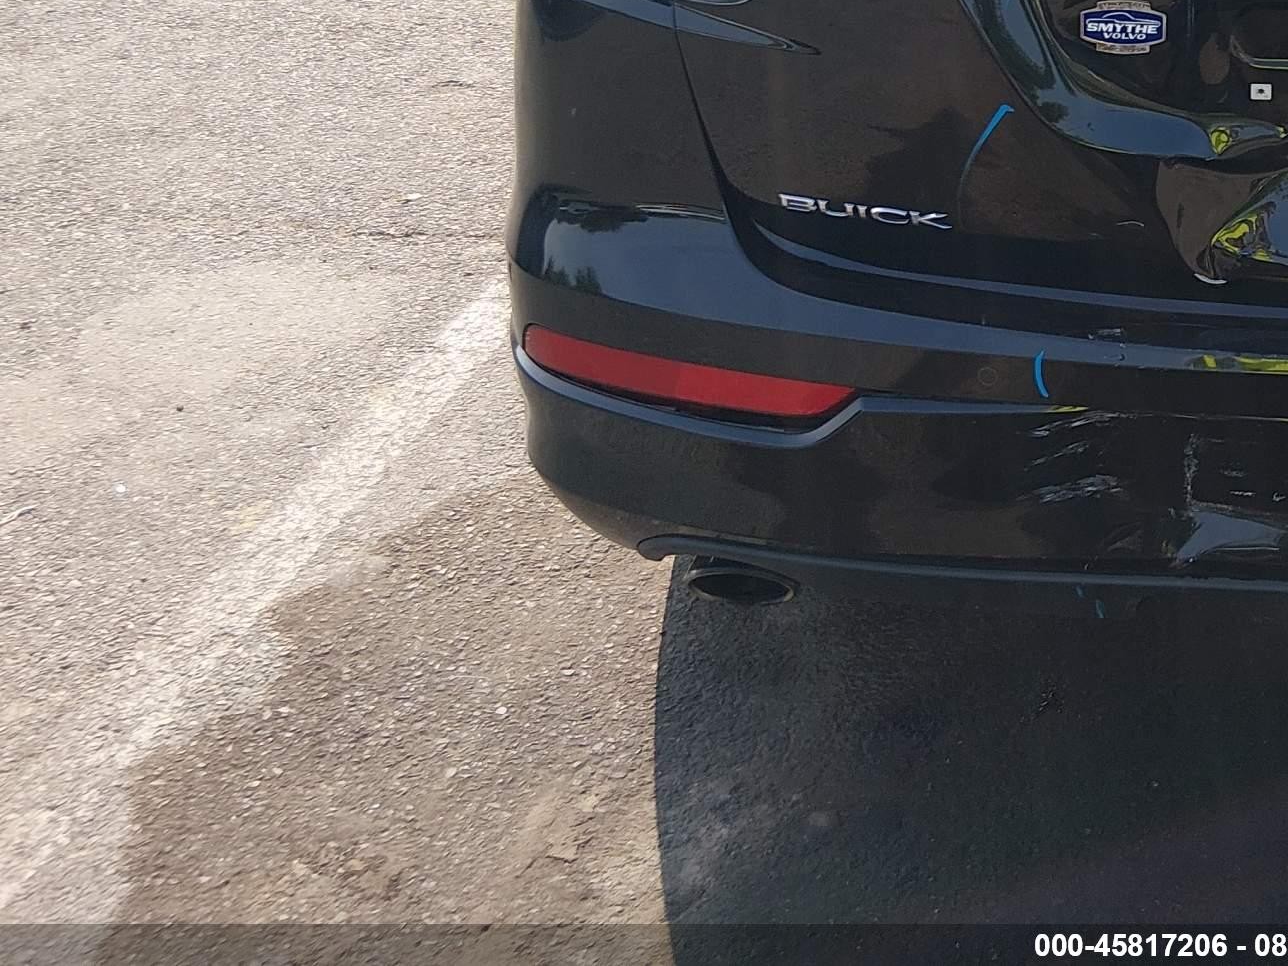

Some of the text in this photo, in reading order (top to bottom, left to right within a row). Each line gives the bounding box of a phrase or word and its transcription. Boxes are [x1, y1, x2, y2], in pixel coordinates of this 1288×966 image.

[1087, 22, 1158, 34] SMYTHE
[1103, 32, 1146, 40] VOLVO
[778, 193, 953, 230] BUICK
